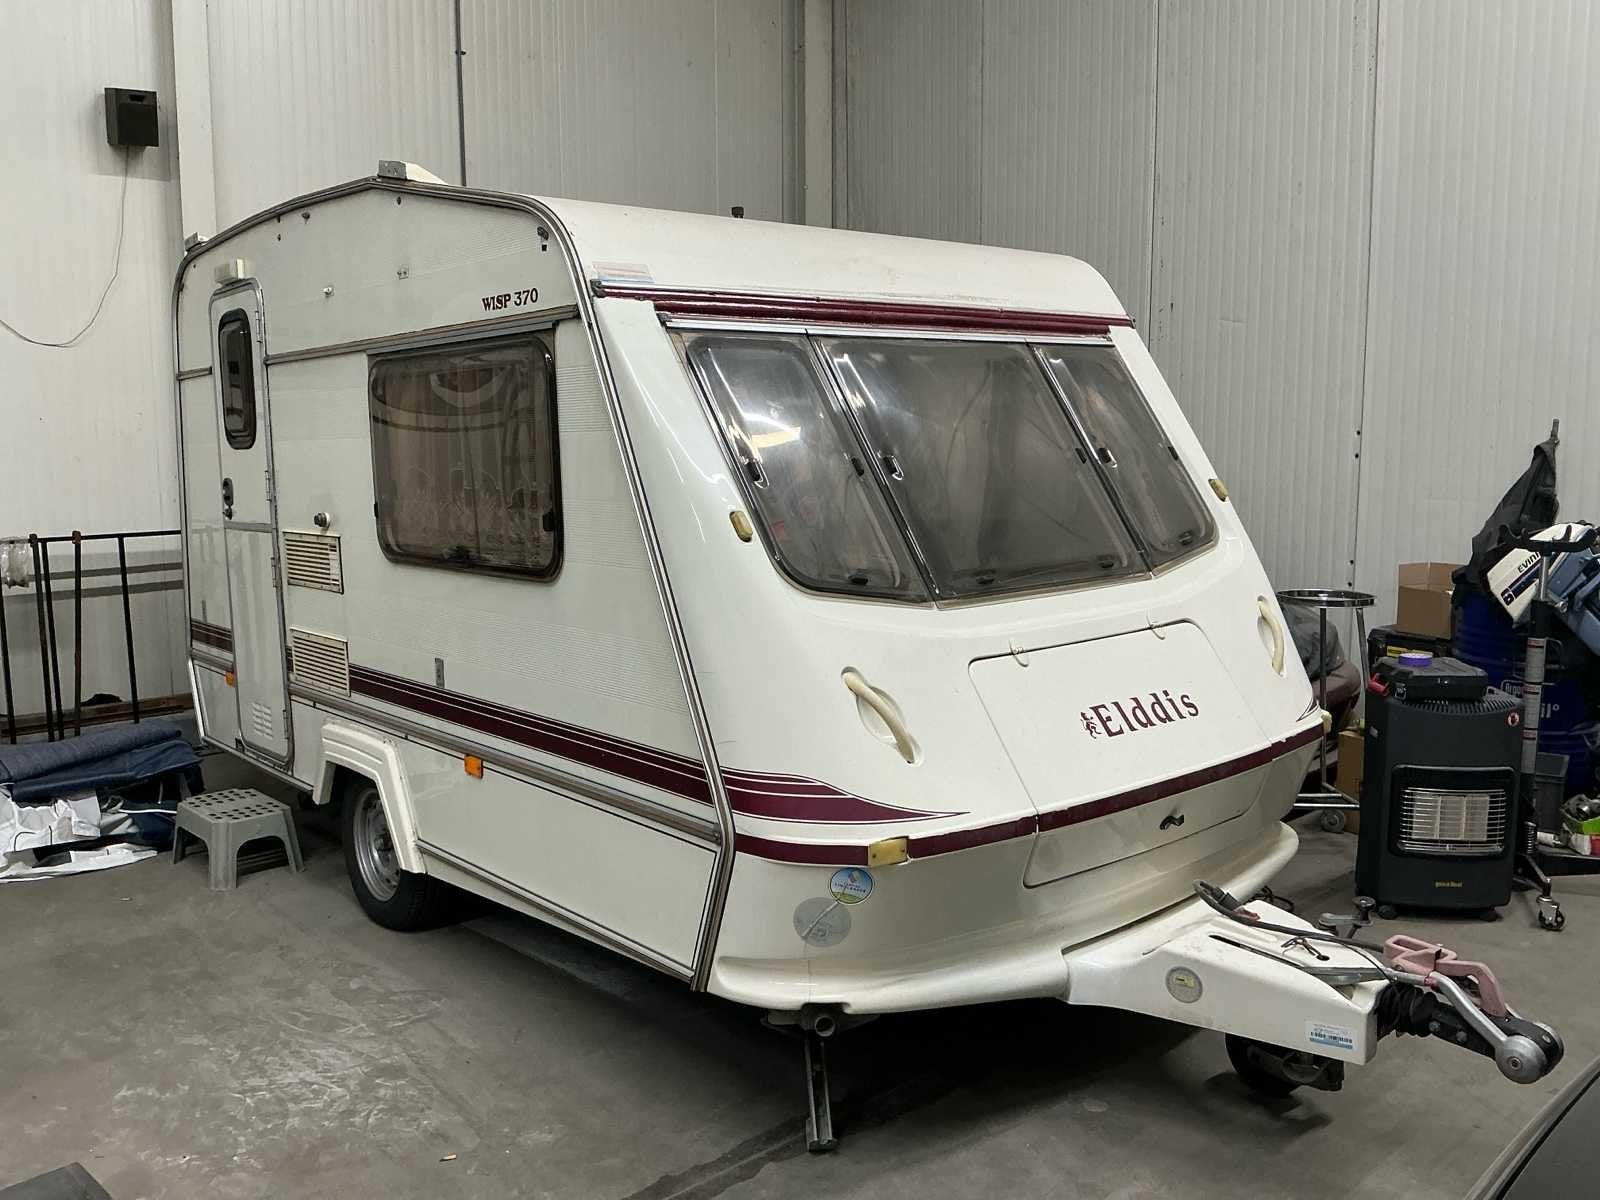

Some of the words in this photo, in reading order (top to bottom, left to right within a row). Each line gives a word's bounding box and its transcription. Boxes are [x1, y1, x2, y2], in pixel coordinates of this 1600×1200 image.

[481, 293, 511, 311] WISP
[514, 287, 538, 306] 370
[1089, 689, 1199, 737] Elddis
